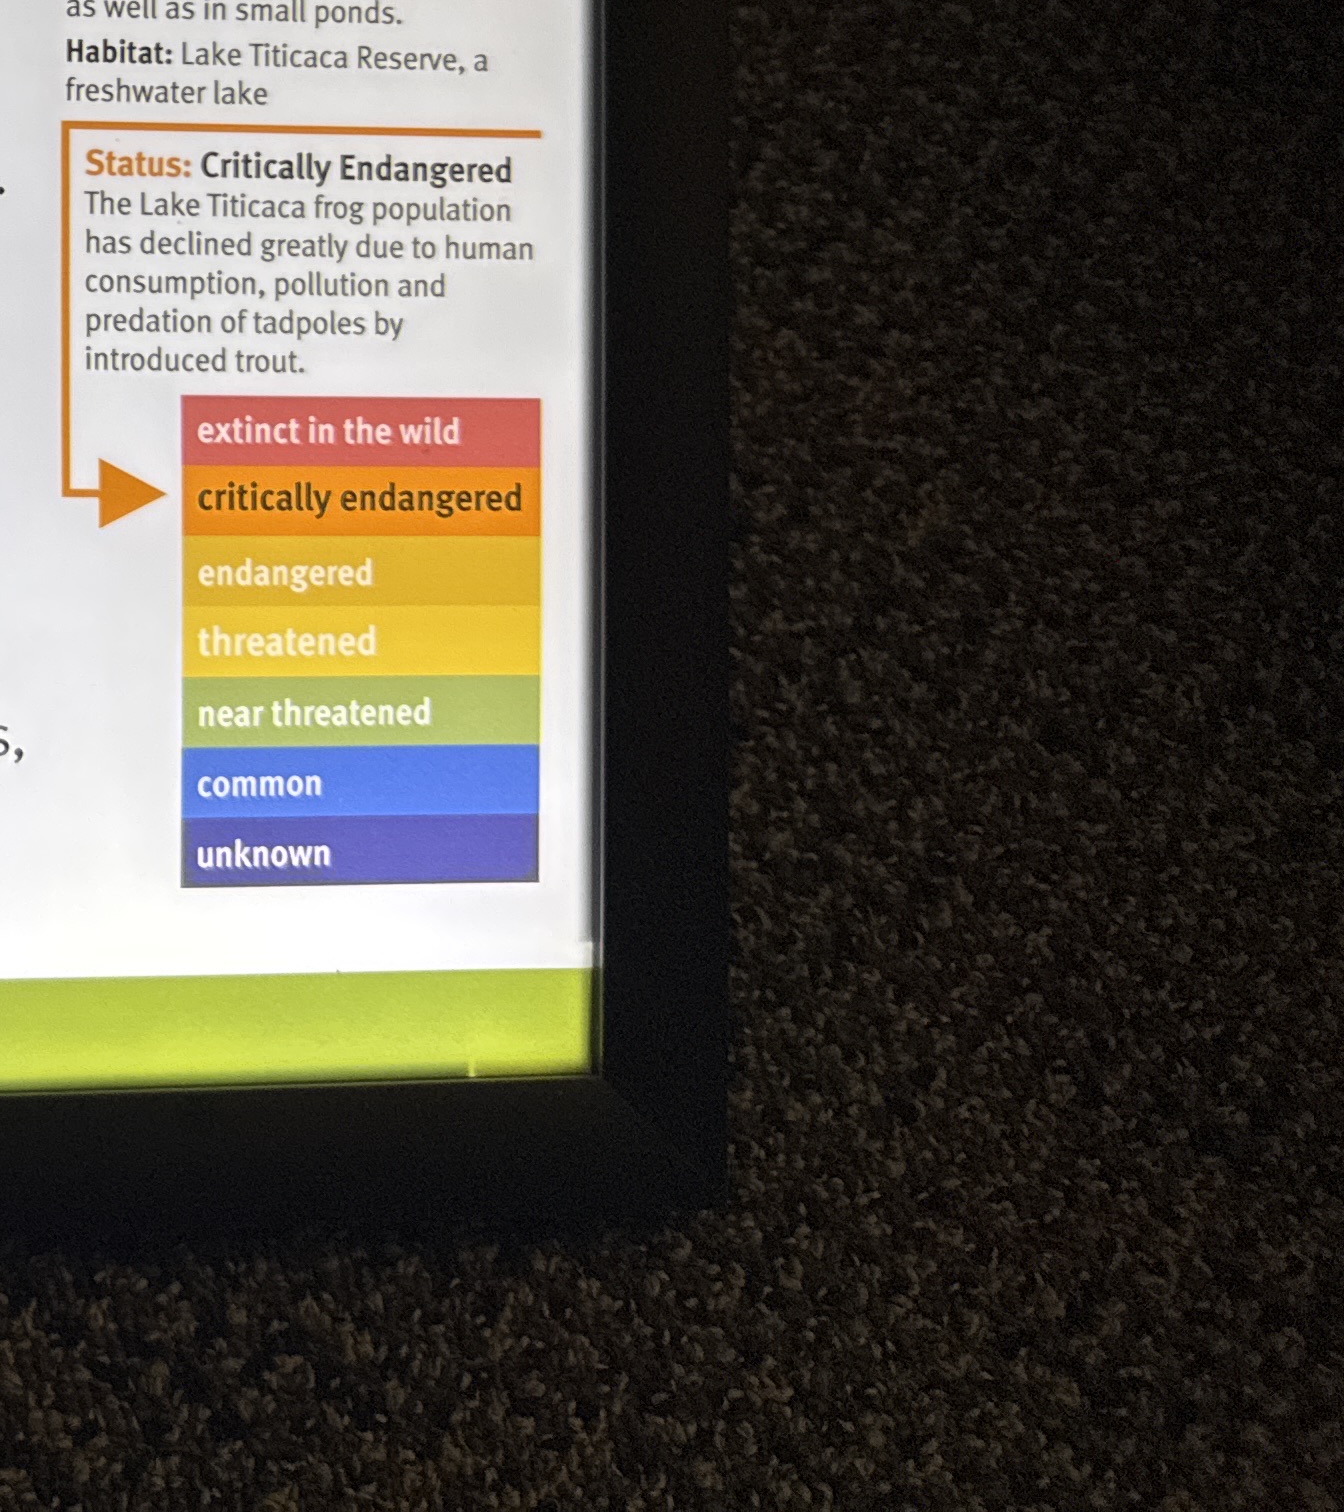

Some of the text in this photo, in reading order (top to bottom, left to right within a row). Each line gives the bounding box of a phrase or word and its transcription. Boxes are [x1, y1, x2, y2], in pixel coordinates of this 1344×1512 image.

[66, 0, 96, 18] as
[165, 1, 195, 20] as
[314, 0, 403, 29] ponds.
[66, 38, 489, 75] Habitat: Lake Titicaca Reserve, a
[65, 76, 268, 106] freshwater lake
[85, 148, 512, 189] Status: Critically Endangered
[83, 189, 511, 227] The Lake Titicaca frog population
[85, 228, 534, 264] has declined greatly due to human
[85, 269, 446, 302] consumption, pollution and
[85, 306, 404, 342] predation of tadpoles by
[85, 345, 305, 374] introduced trout.
[197, 414, 460, 445] extinct in the wild
[198, 480, 522, 520] critically endangered
[198, 557, 374, 593] endangered
[198, 624, 377, 657] threatened
[198, 696, 432, 728] near threatened
[197, 774, 322, 798] common
[197, 838, 331, 869] unknown
